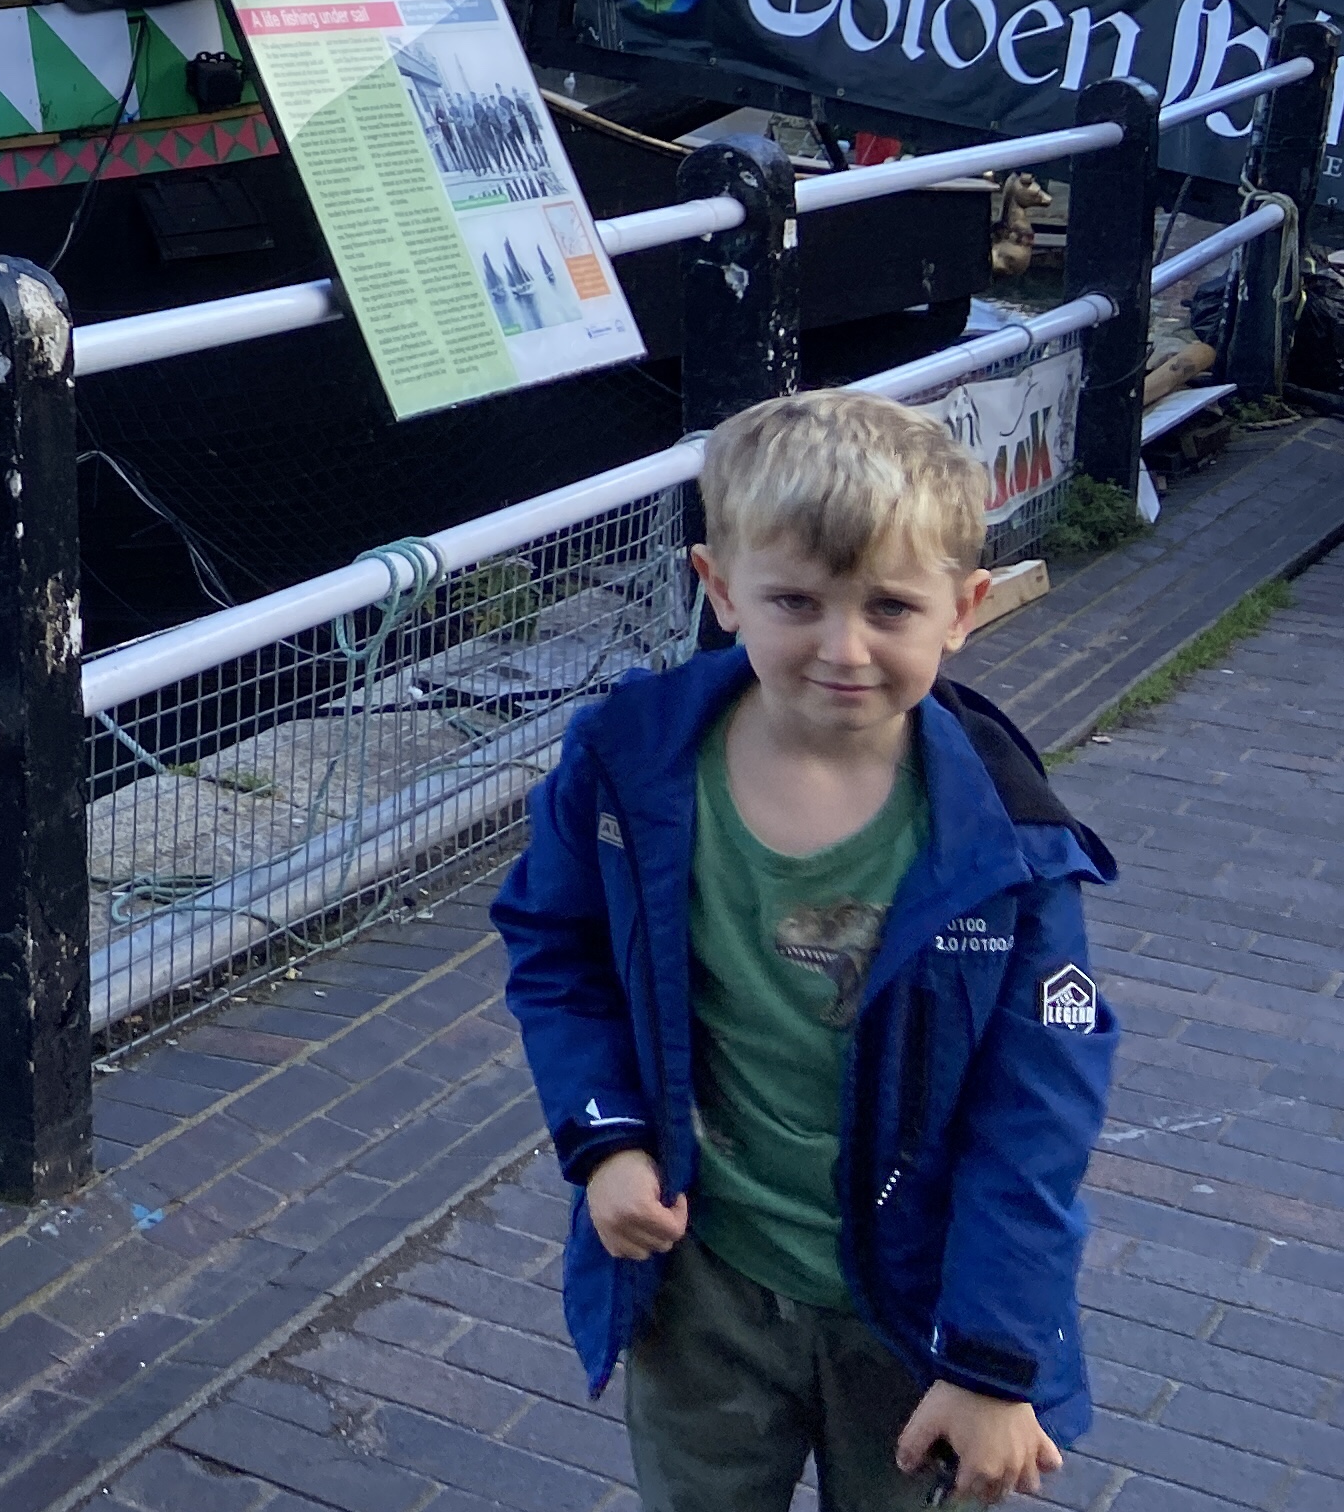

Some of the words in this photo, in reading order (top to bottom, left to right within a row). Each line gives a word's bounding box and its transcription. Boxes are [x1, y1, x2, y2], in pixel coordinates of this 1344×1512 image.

[251, 10, 263, 28] A
[260, 9, 281, 27] life
[280, 7, 319, 29] fishing
[319, 6, 349, 25] under
[350, 5, 370, 23] sail
